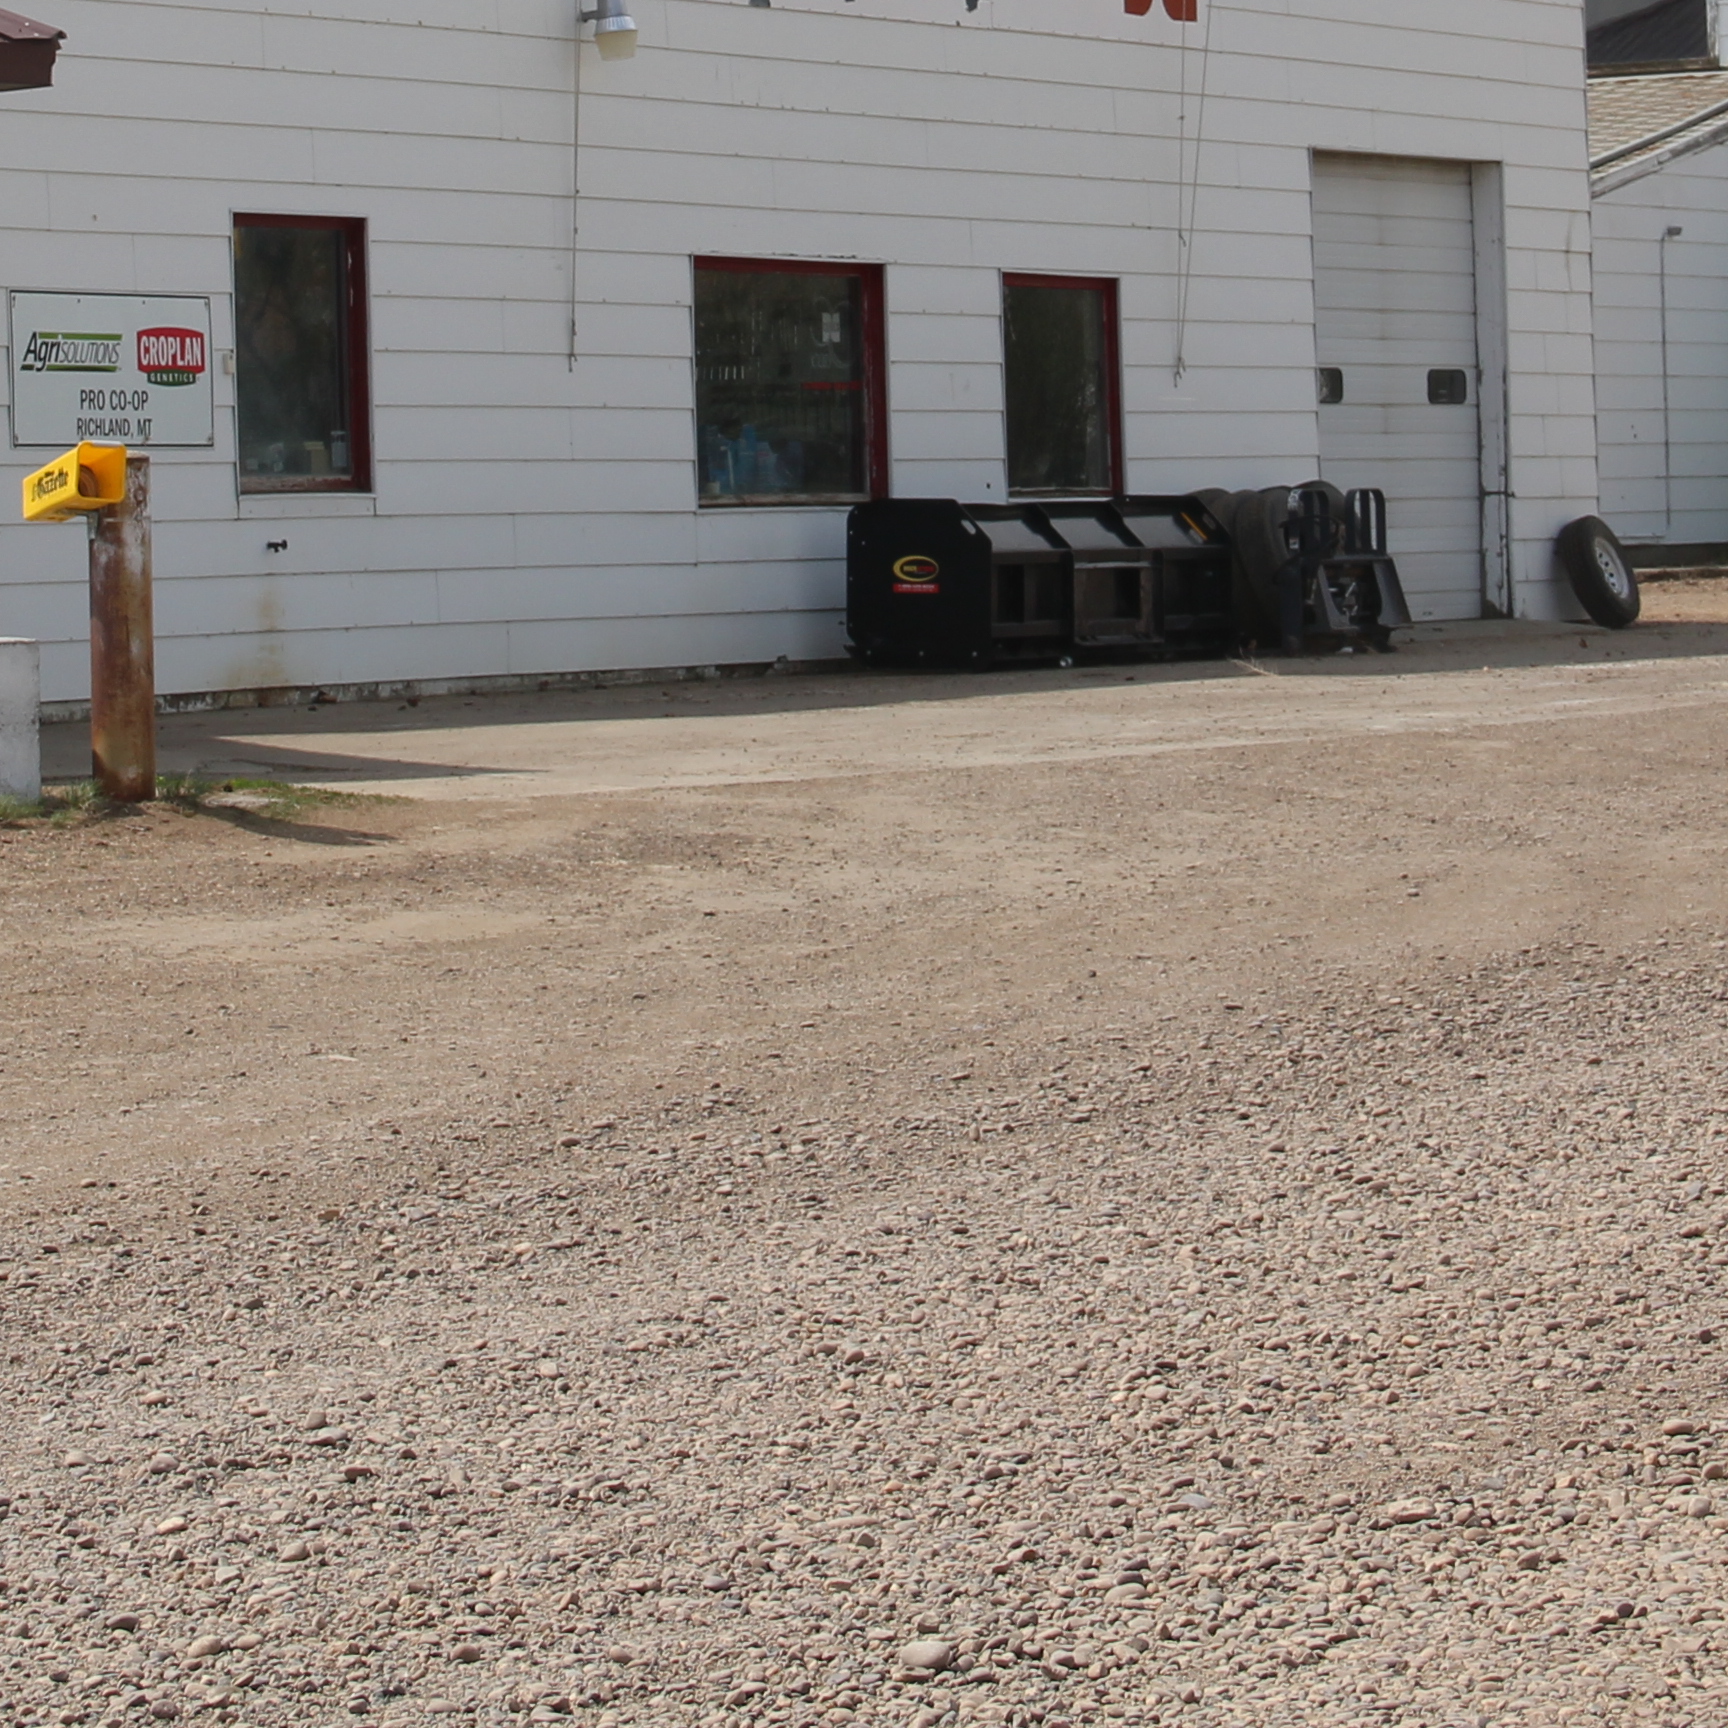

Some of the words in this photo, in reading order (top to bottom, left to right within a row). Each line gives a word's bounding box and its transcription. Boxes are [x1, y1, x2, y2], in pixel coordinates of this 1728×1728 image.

[140, 335, 202, 366] CROPLAN
[150, 373, 194, 383] GENETICS
[79, 389, 106, 410] PRO
[110, 389, 149, 411] CO-OP
[77, 417, 135, 439] RICHLAND,
[137, 418, 153, 437] MT
